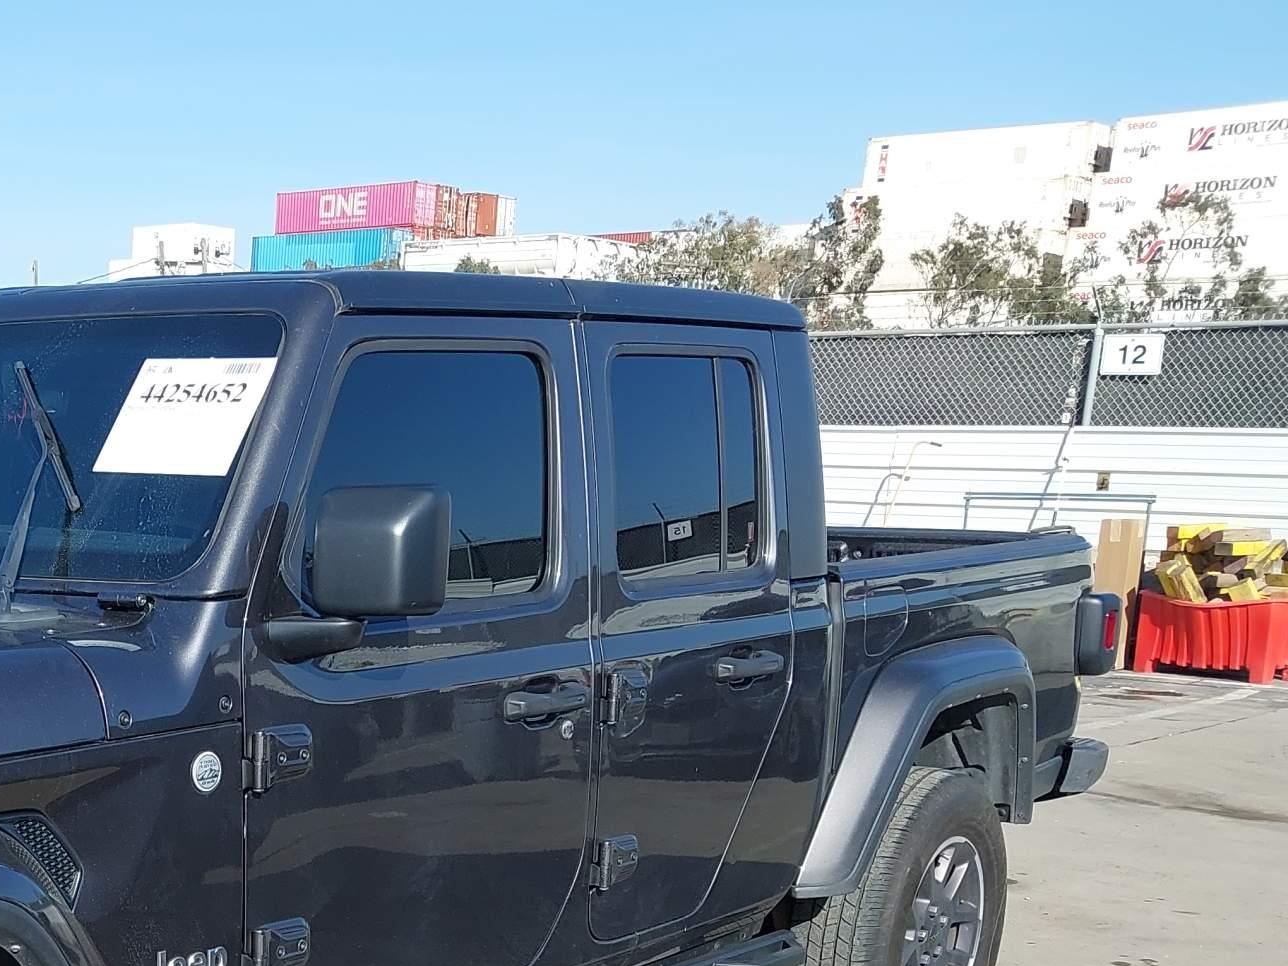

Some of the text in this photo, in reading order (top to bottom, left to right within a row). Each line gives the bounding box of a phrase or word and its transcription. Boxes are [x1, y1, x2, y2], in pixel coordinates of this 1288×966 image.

[1127, 120, 1158, 131] seaco
[1220, 117, 1288, 137] HORIZO
[1102, 176, 1133, 186] seaco
[1194, 175, 1278, 194] HORIZON
[319, 191, 368, 218] ONE
[1076, 231, 1107, 241] seaco
[1169, 234, 1249, 251] HORIZON
[1118, 344, 1147, 365] 12
[140, 382, 248, 403] 44254652
